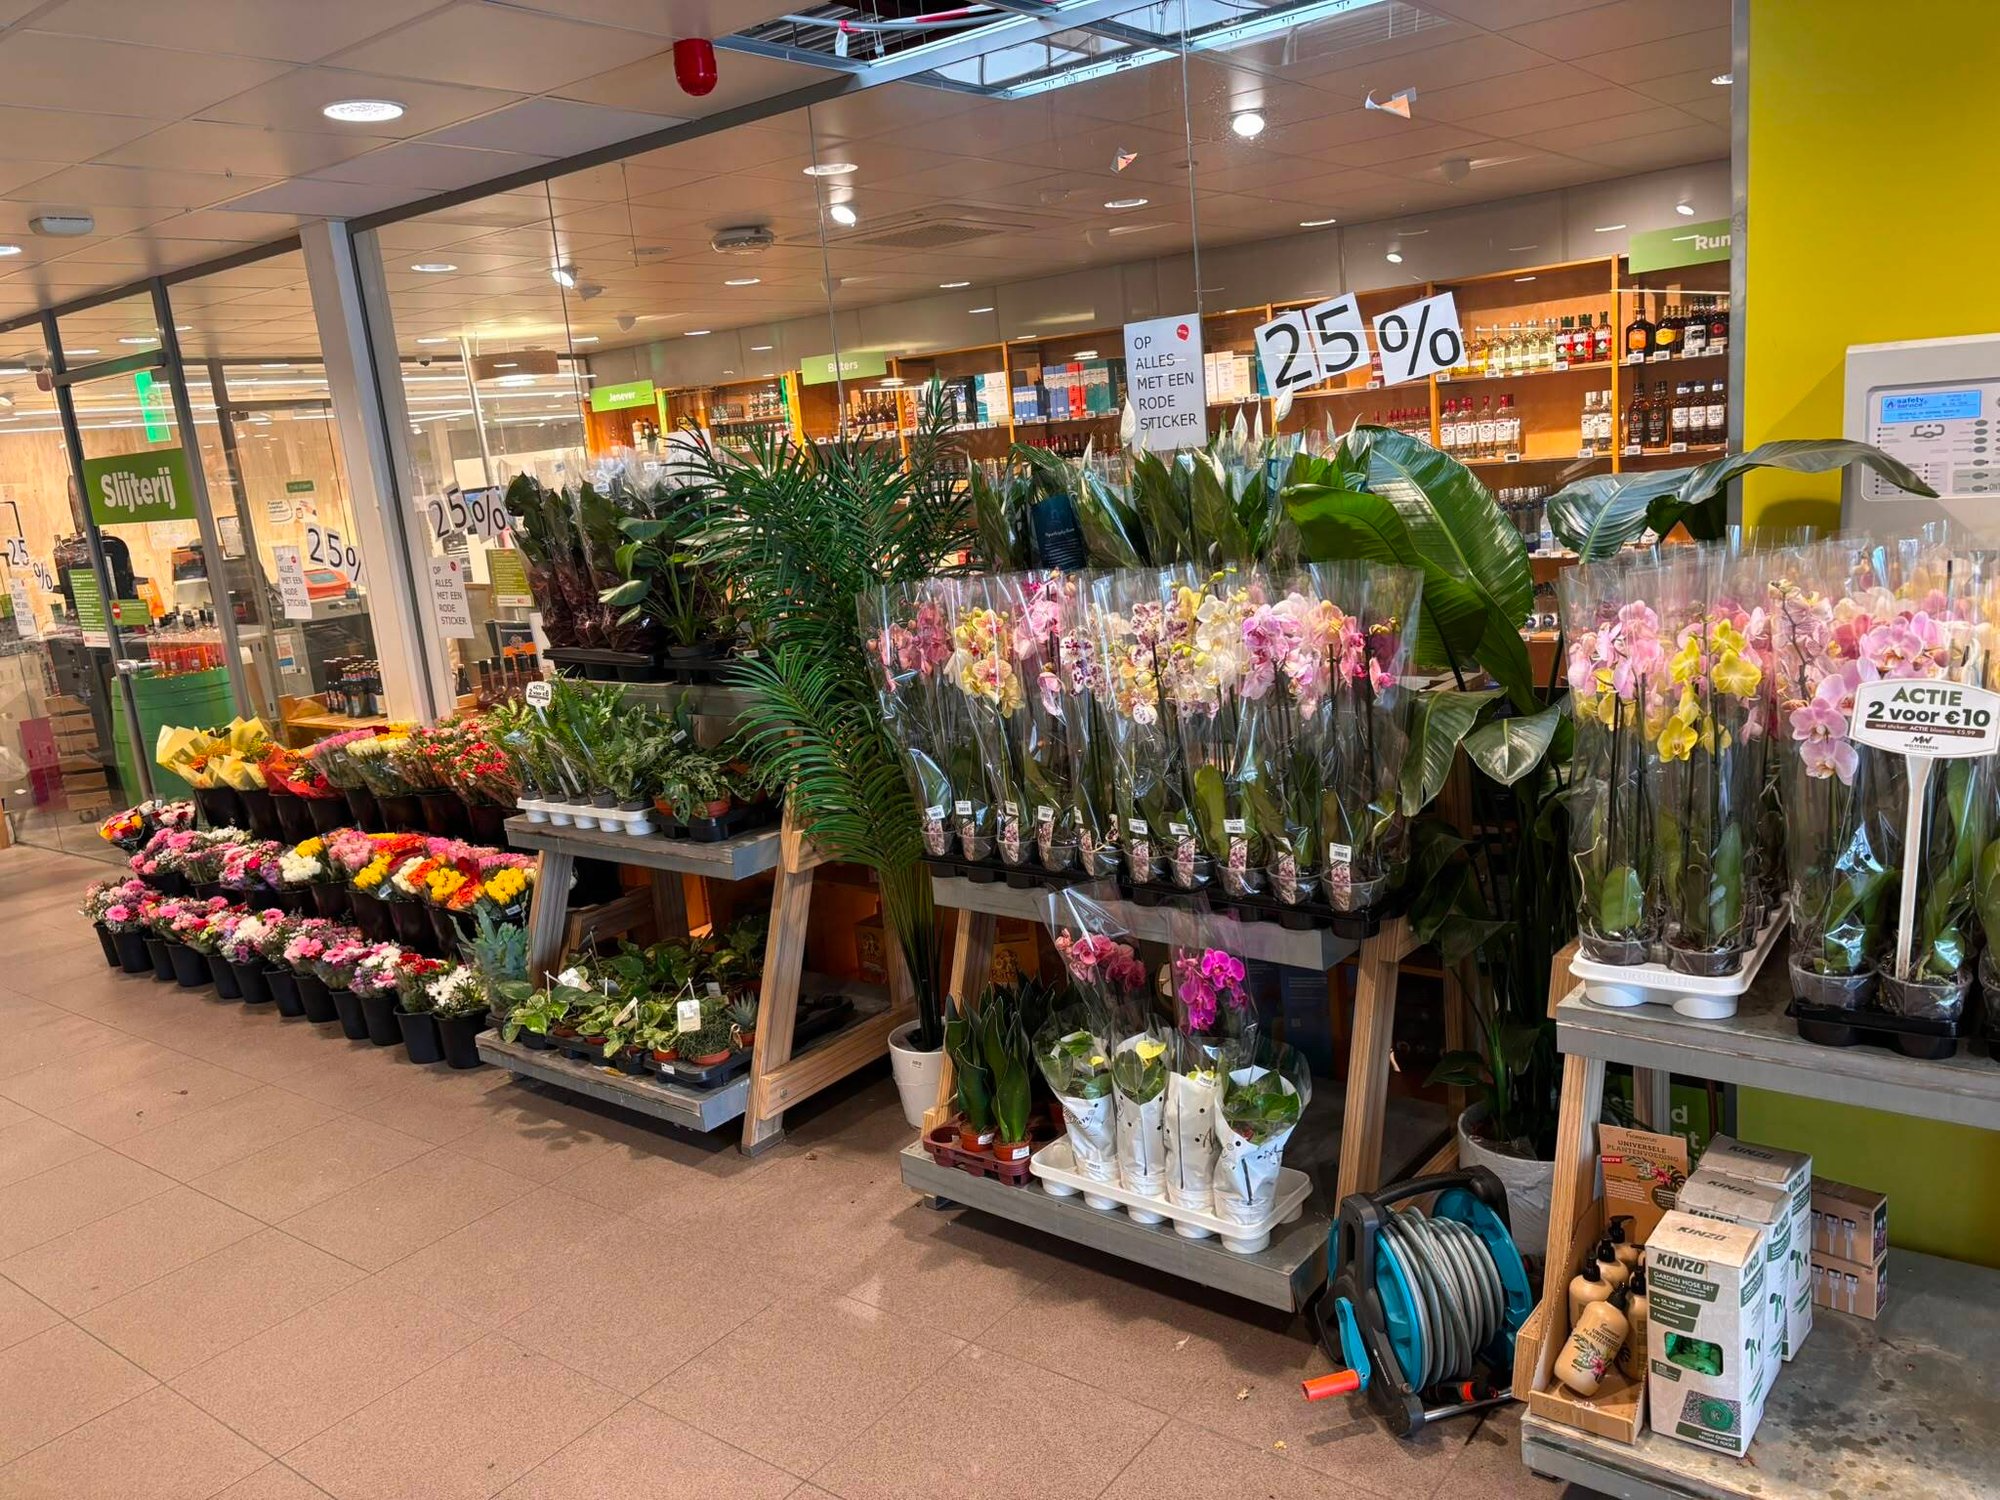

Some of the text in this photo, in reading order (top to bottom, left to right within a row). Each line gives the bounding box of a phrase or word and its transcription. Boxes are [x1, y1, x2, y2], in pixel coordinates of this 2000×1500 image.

[1133, 335, 1152, 350] OP
[1264, 304, 1461, 389] 25%
[1135, 353, 1176, 371] ALLES
[1137, 372, 1194, 390] MET EEN
[609, 391, 636, 402] Jenever
[1138, 395, 1176, 411] RODE
[1140, 412, 1198, 431] STICKER
[101, 467, 176, 513] Slijterij
[428, 488, 506, 538] 25%
[7, 539, 53, 590] 25%
[432, 565, 442, 575] OP
[434, 577, 454, 588] ALLES
[436, 590, 463, 601] MET EEN
[438, 603, 456, 613] RODE
[440, 615, 468, 626] STICKER
[1891, 686, 1963, 707] ACTIE
[1867, 700, 1991, 728] 2 voor €10
[1617, 1140, 1667, 1154] UNIVERSELE
[1727, 1145, 1775, 1160] KINZO
[1706, 1180, 1757, 1196] KINZO
[1676, 1226, 1729, 1241] KINZO
[1656, 1253, 1705, 1275] KINZO
[1653, 1271, 1681, 1285] GARDEN
[1682, 1279, 1701, 1289] HOSE
[1702, 1283, 1715, 1292] SET
